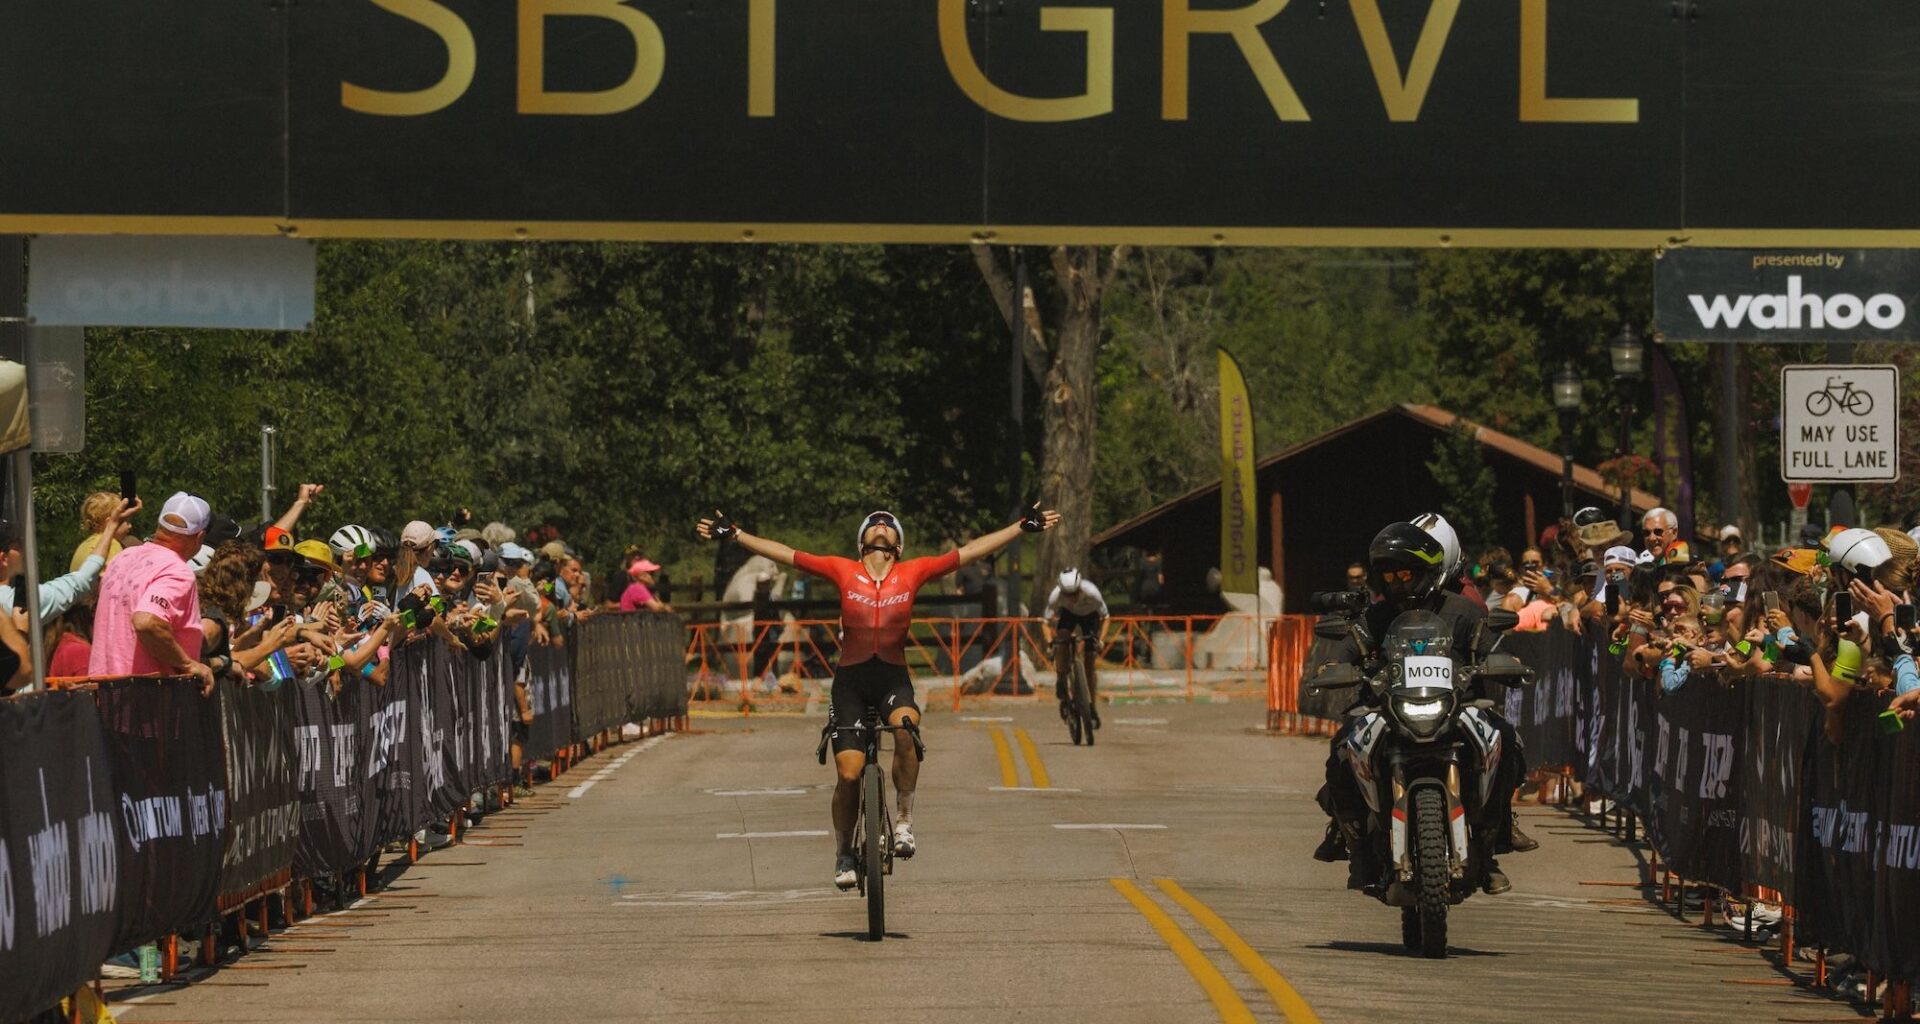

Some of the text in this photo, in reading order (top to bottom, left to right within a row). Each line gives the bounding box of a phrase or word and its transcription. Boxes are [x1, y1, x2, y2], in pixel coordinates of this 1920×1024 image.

[1753, 253, 1845, 269] presented by
[1688, 275, 1906, 329] wahoo
[1801, 426, 1878, 442] MAY USE
[1792, 451, 1887, 467] FULL LANE
[847, 591, 910, 607] SPECIALIZED
[1408, 666, 1450, 679] MOTO
